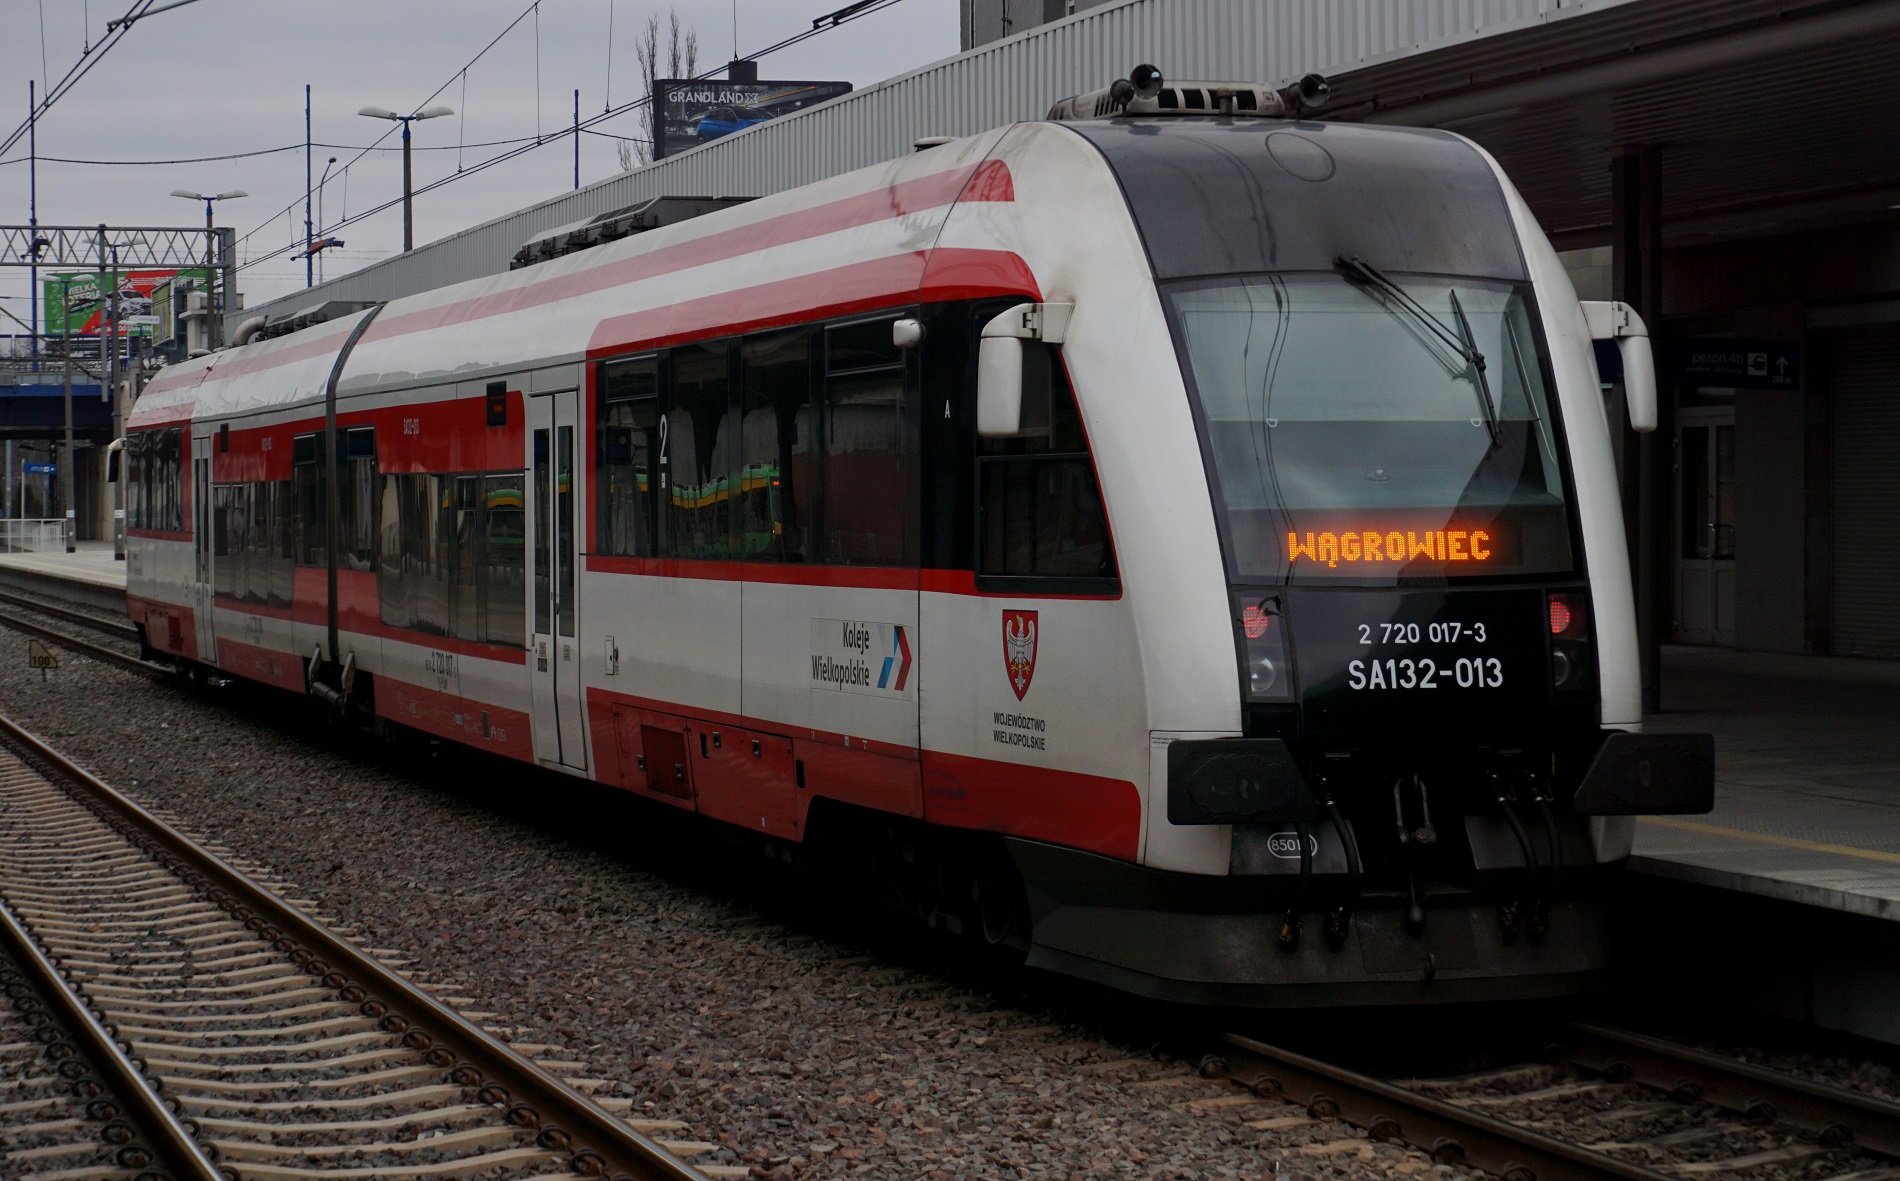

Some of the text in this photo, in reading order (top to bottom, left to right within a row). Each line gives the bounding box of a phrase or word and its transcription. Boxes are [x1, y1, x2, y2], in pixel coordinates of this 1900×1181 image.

[669, 91, 743, 103] GRANDLAND
[1692, 352, 1744, 365] peron 4b
[944, 400, 951, 419] A
[659, 413, 668, 464] 2
[1288, 531, 1491, 568] WĄGROWIEC
[843, 622, 870, 655] Koleje
[1358, 622, 1487, 645] 2 720 017-3
[32, 656, 50, 666] 100
[812, 655, 870, 691] Wielkopolskie
[1348, 657, 1504, 690] SA132-013
[993, 711, 1046, 732] WOJEWÓDZTWO
[993, 730, 1046, 751] WIELKOPOLSKIE
